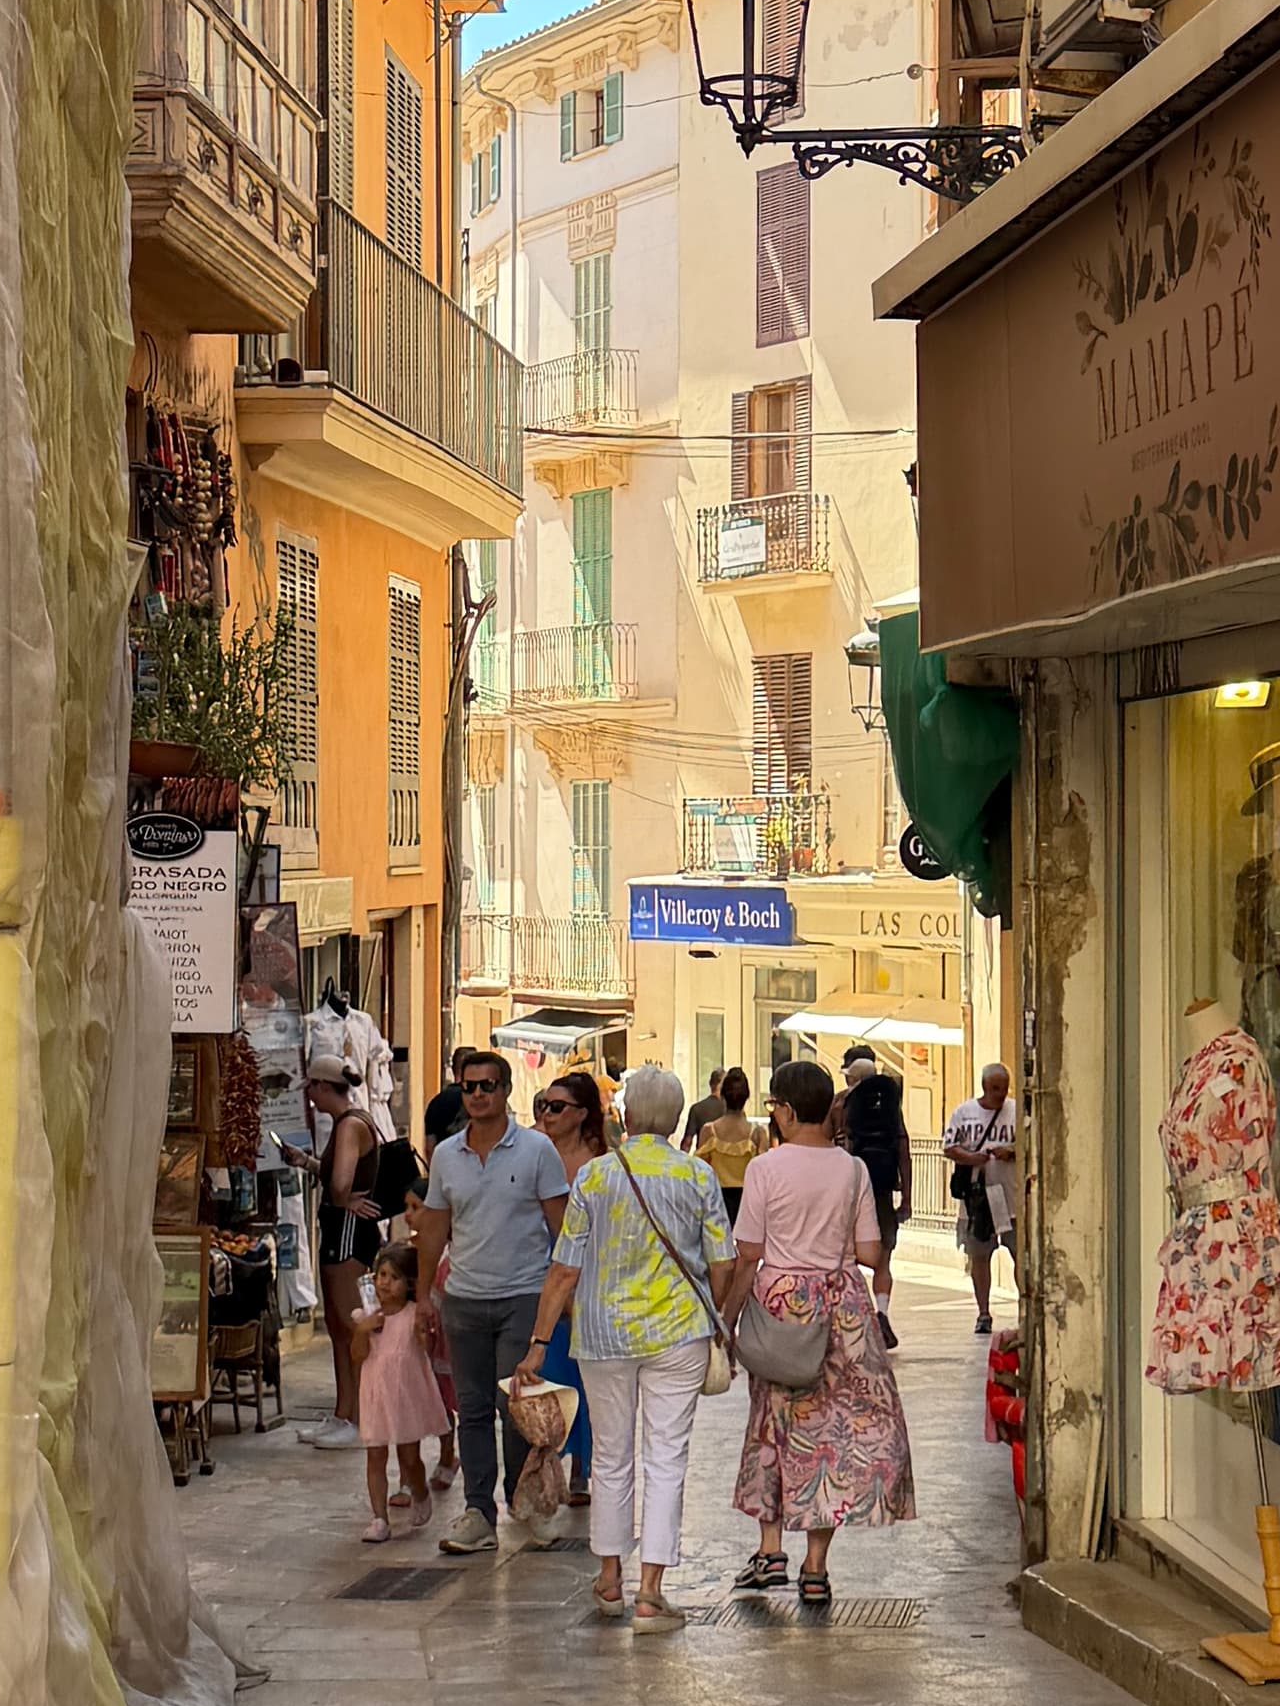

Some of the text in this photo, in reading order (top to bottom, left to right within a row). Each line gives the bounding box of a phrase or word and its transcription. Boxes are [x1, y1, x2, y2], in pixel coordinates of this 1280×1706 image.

[1096, 258, 1254, 444] MAMAPÉ
[163, 881, 227, 892] NEGRO
[659, 898, 781, 933] Villeroy & Boch
[859, 910, 902, 936] LAS
[175, 984, 213, 995] OLIVA
